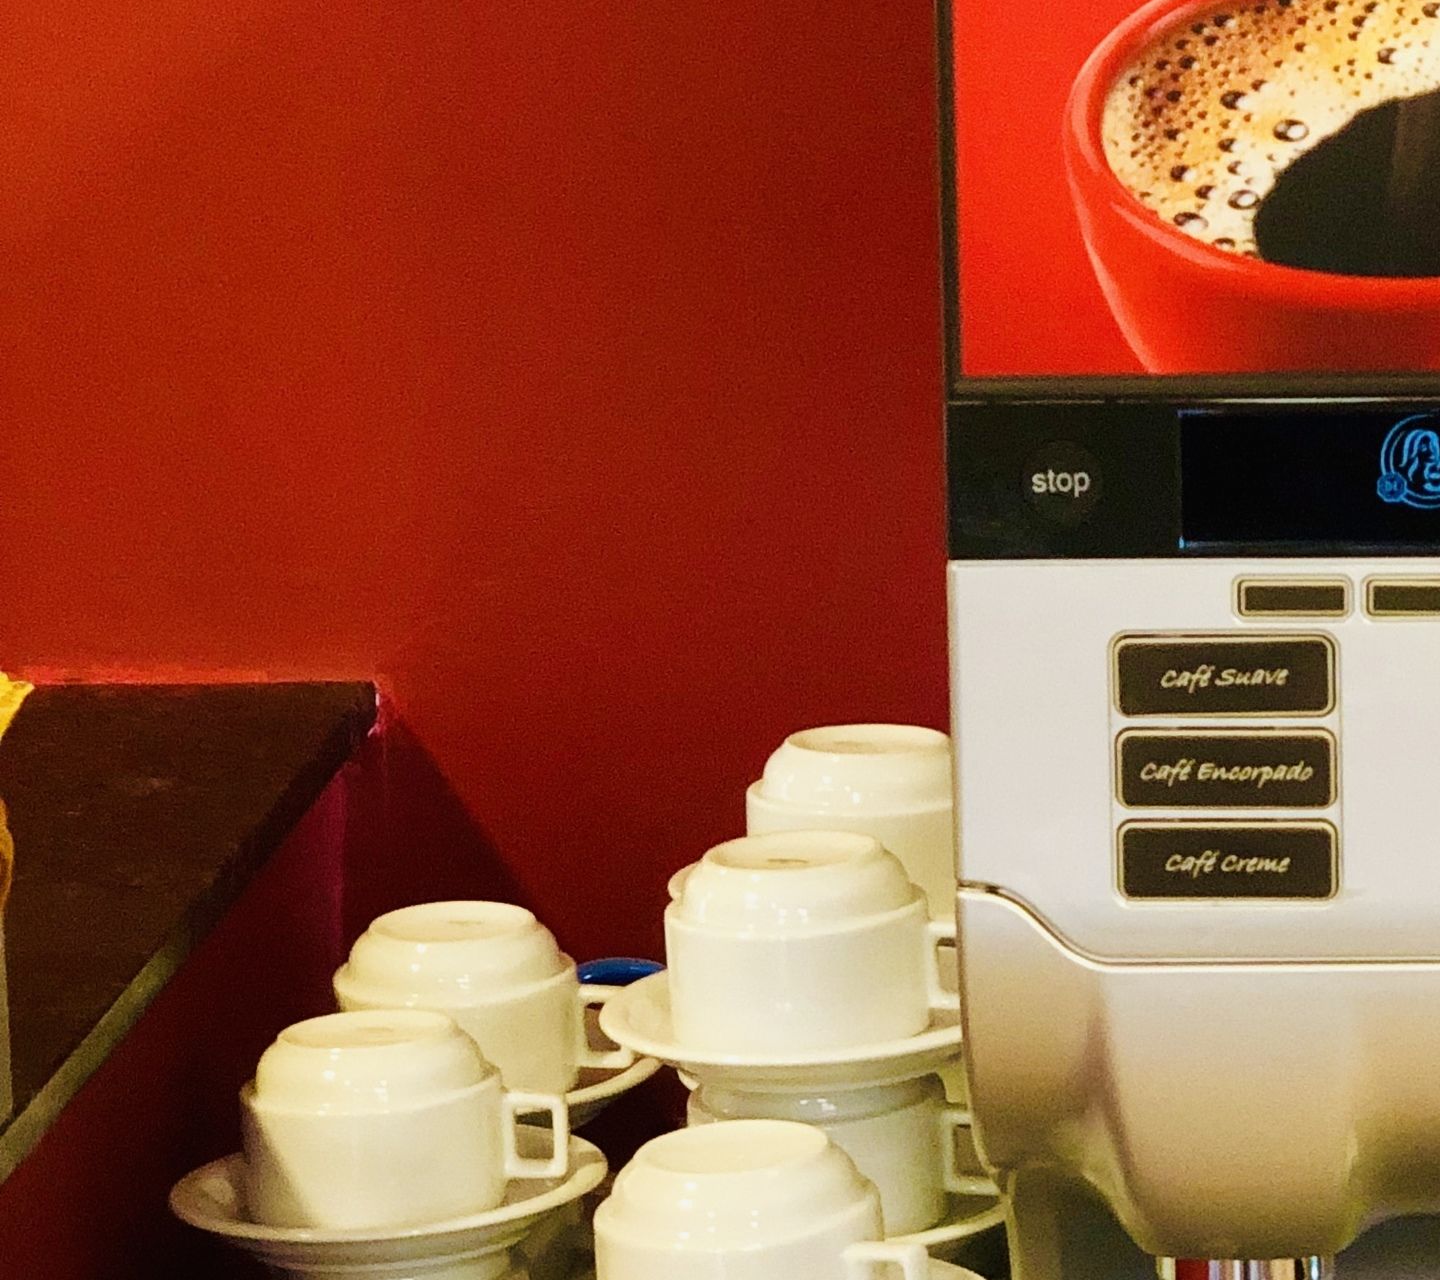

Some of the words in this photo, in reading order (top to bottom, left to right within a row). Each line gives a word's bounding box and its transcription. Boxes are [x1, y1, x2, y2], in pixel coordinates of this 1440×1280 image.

[1031, 468, 1091, 498] stop
[1160, 664, 1215, 694] Café
[1215, 668, 1289, 687] Suave
[1140, 758, 1195, 787] Café
[1197, 760, 1313, 789] Encorpado
[1165, 849, 1220, 878] Café
[1221, 854, 1291, 873] Creme
